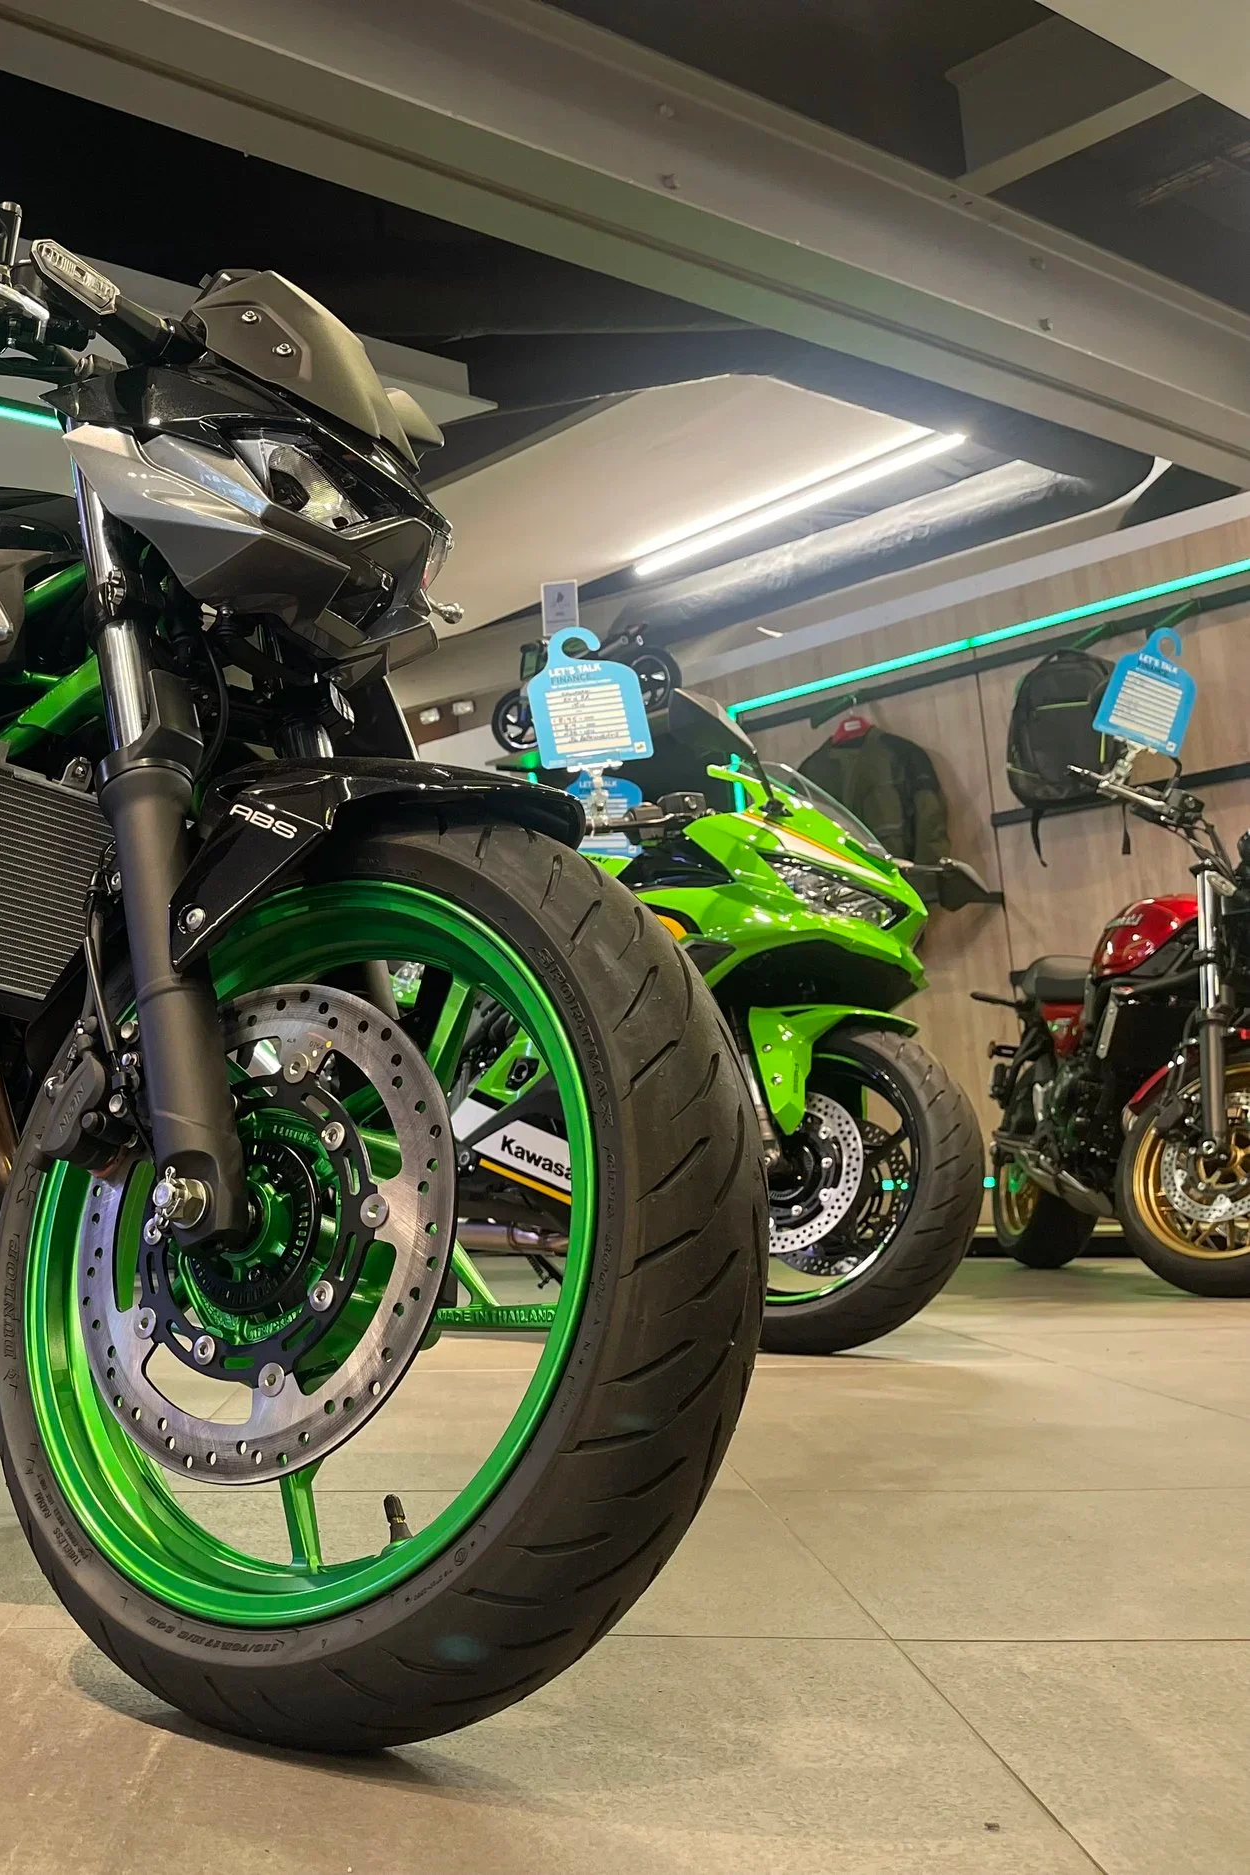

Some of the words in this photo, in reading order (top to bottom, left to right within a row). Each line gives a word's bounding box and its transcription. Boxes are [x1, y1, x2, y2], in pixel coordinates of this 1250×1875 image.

[548, 666, 577, 678] LET'S
[578, 663, 602, 673] TALK
[229, 803, 298, 839] ABS
[536, 947, 614, 1128] SPORTMAX
[2, 1232, 21, 1360] DUNLOP
[436, 1308, 471, 1323] MADE
[473, 1309, 488, 1324] IN
[490, 1308, 556, 1324] THAILAND
